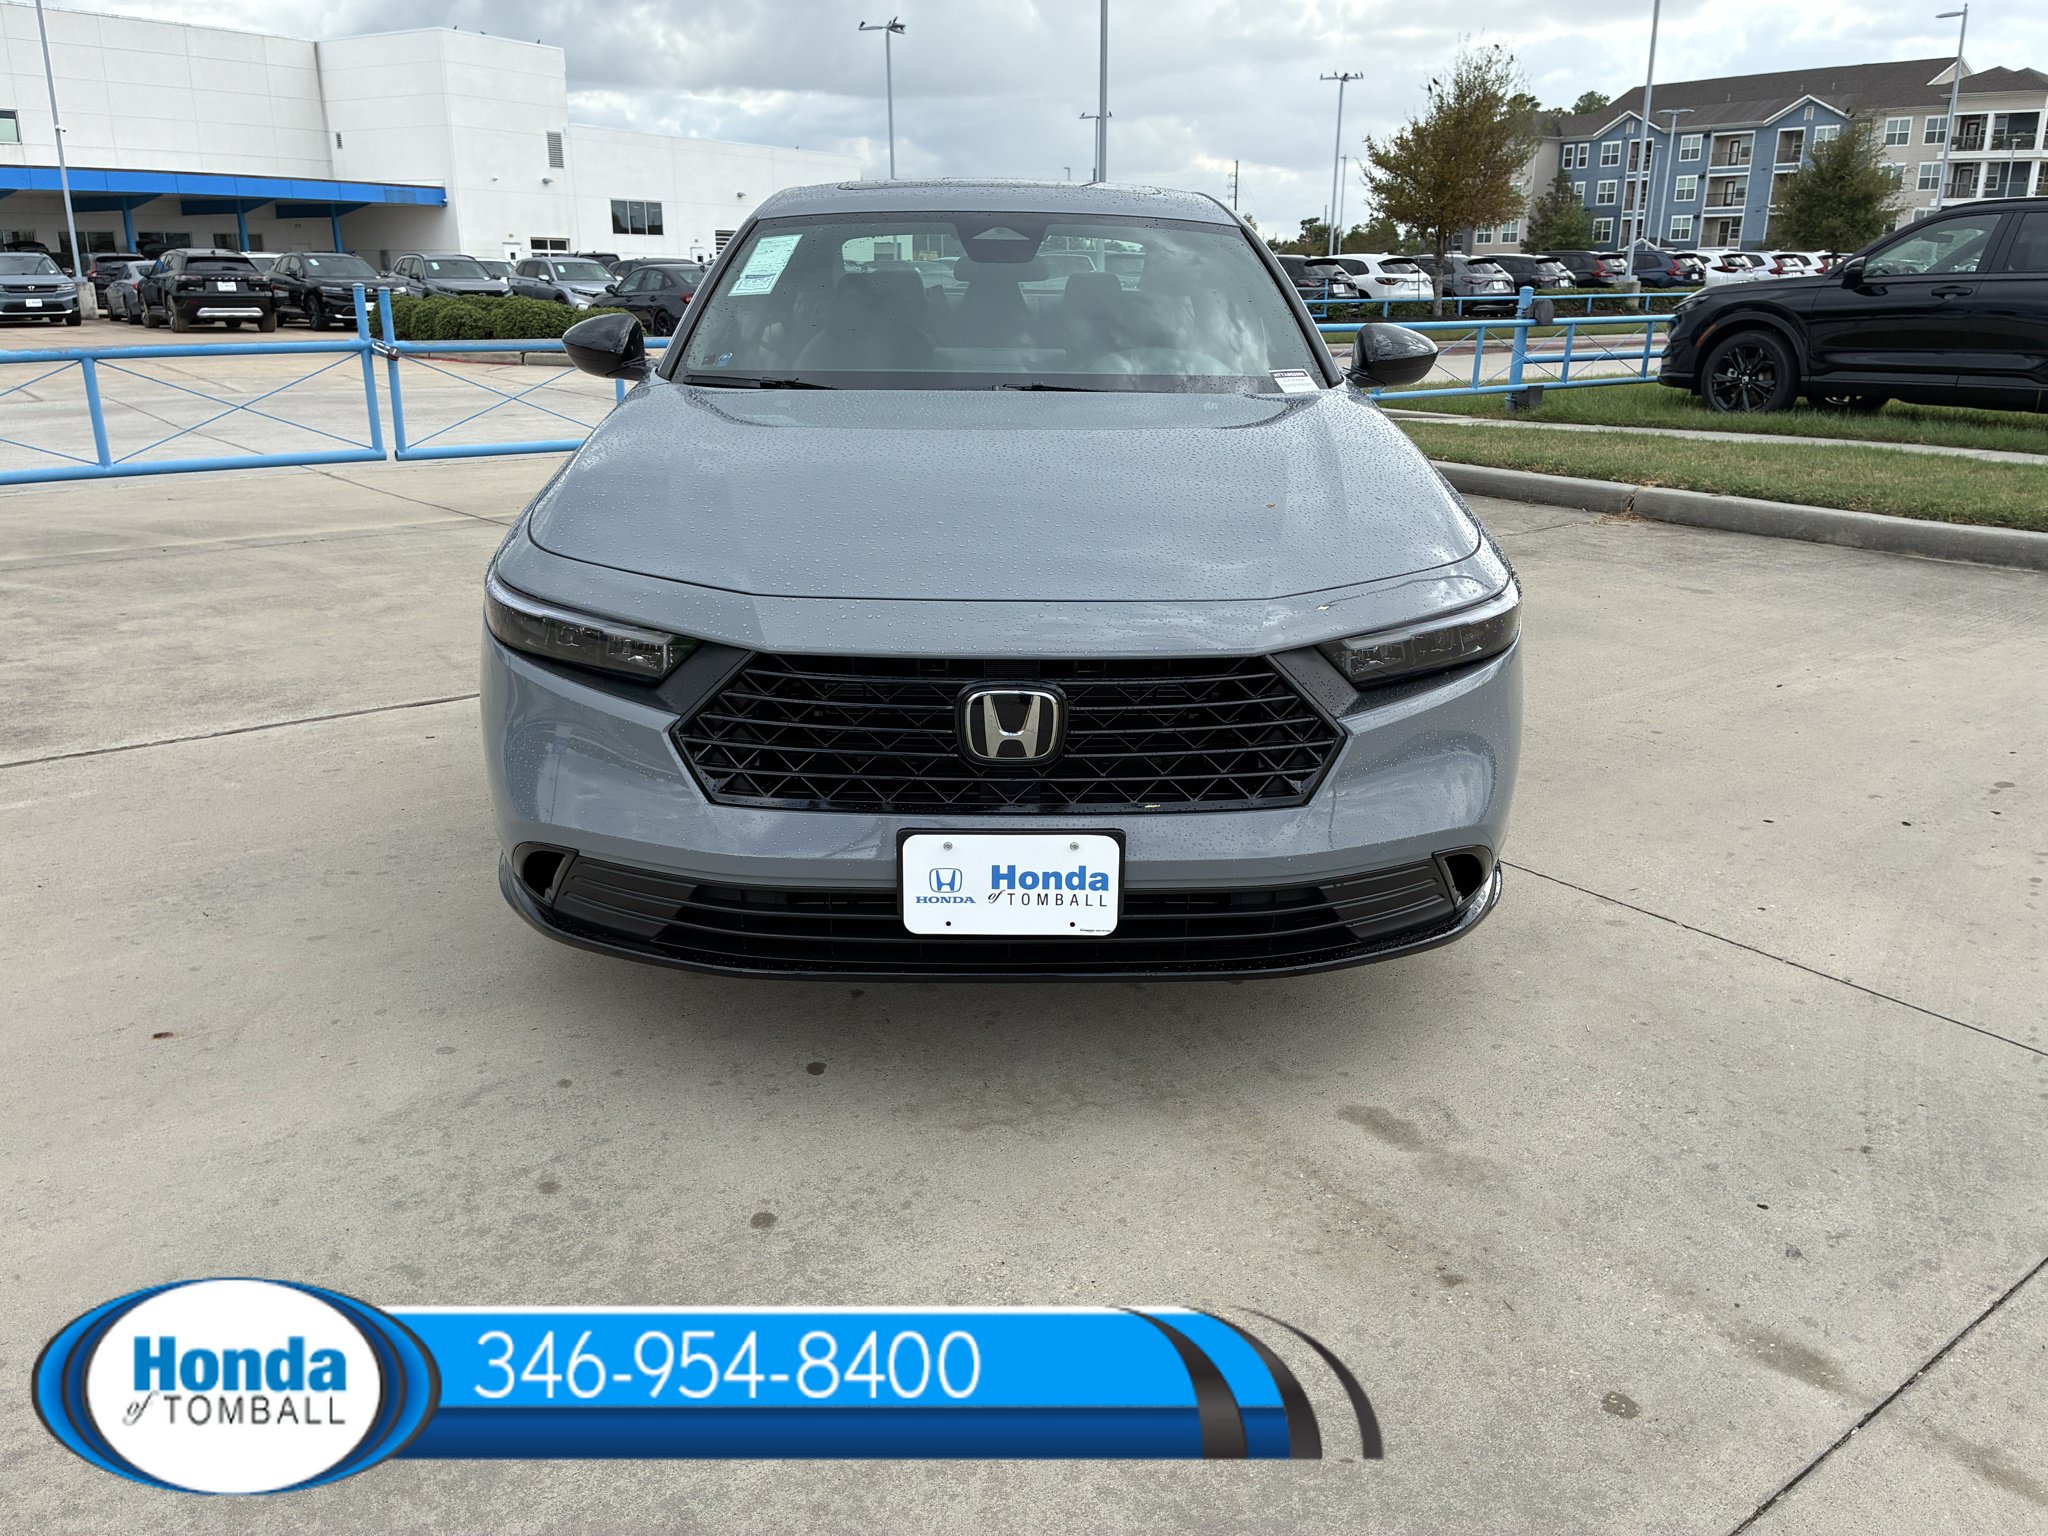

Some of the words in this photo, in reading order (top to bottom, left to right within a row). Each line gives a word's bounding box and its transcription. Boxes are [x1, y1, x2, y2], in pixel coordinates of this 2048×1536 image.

[991, 864, 1109, 892] Honda
[915, 895, 976, 904] HONDA
[987, 889, 1006, 904] of
[1008, 892, 1108, 907] TOMBALL
